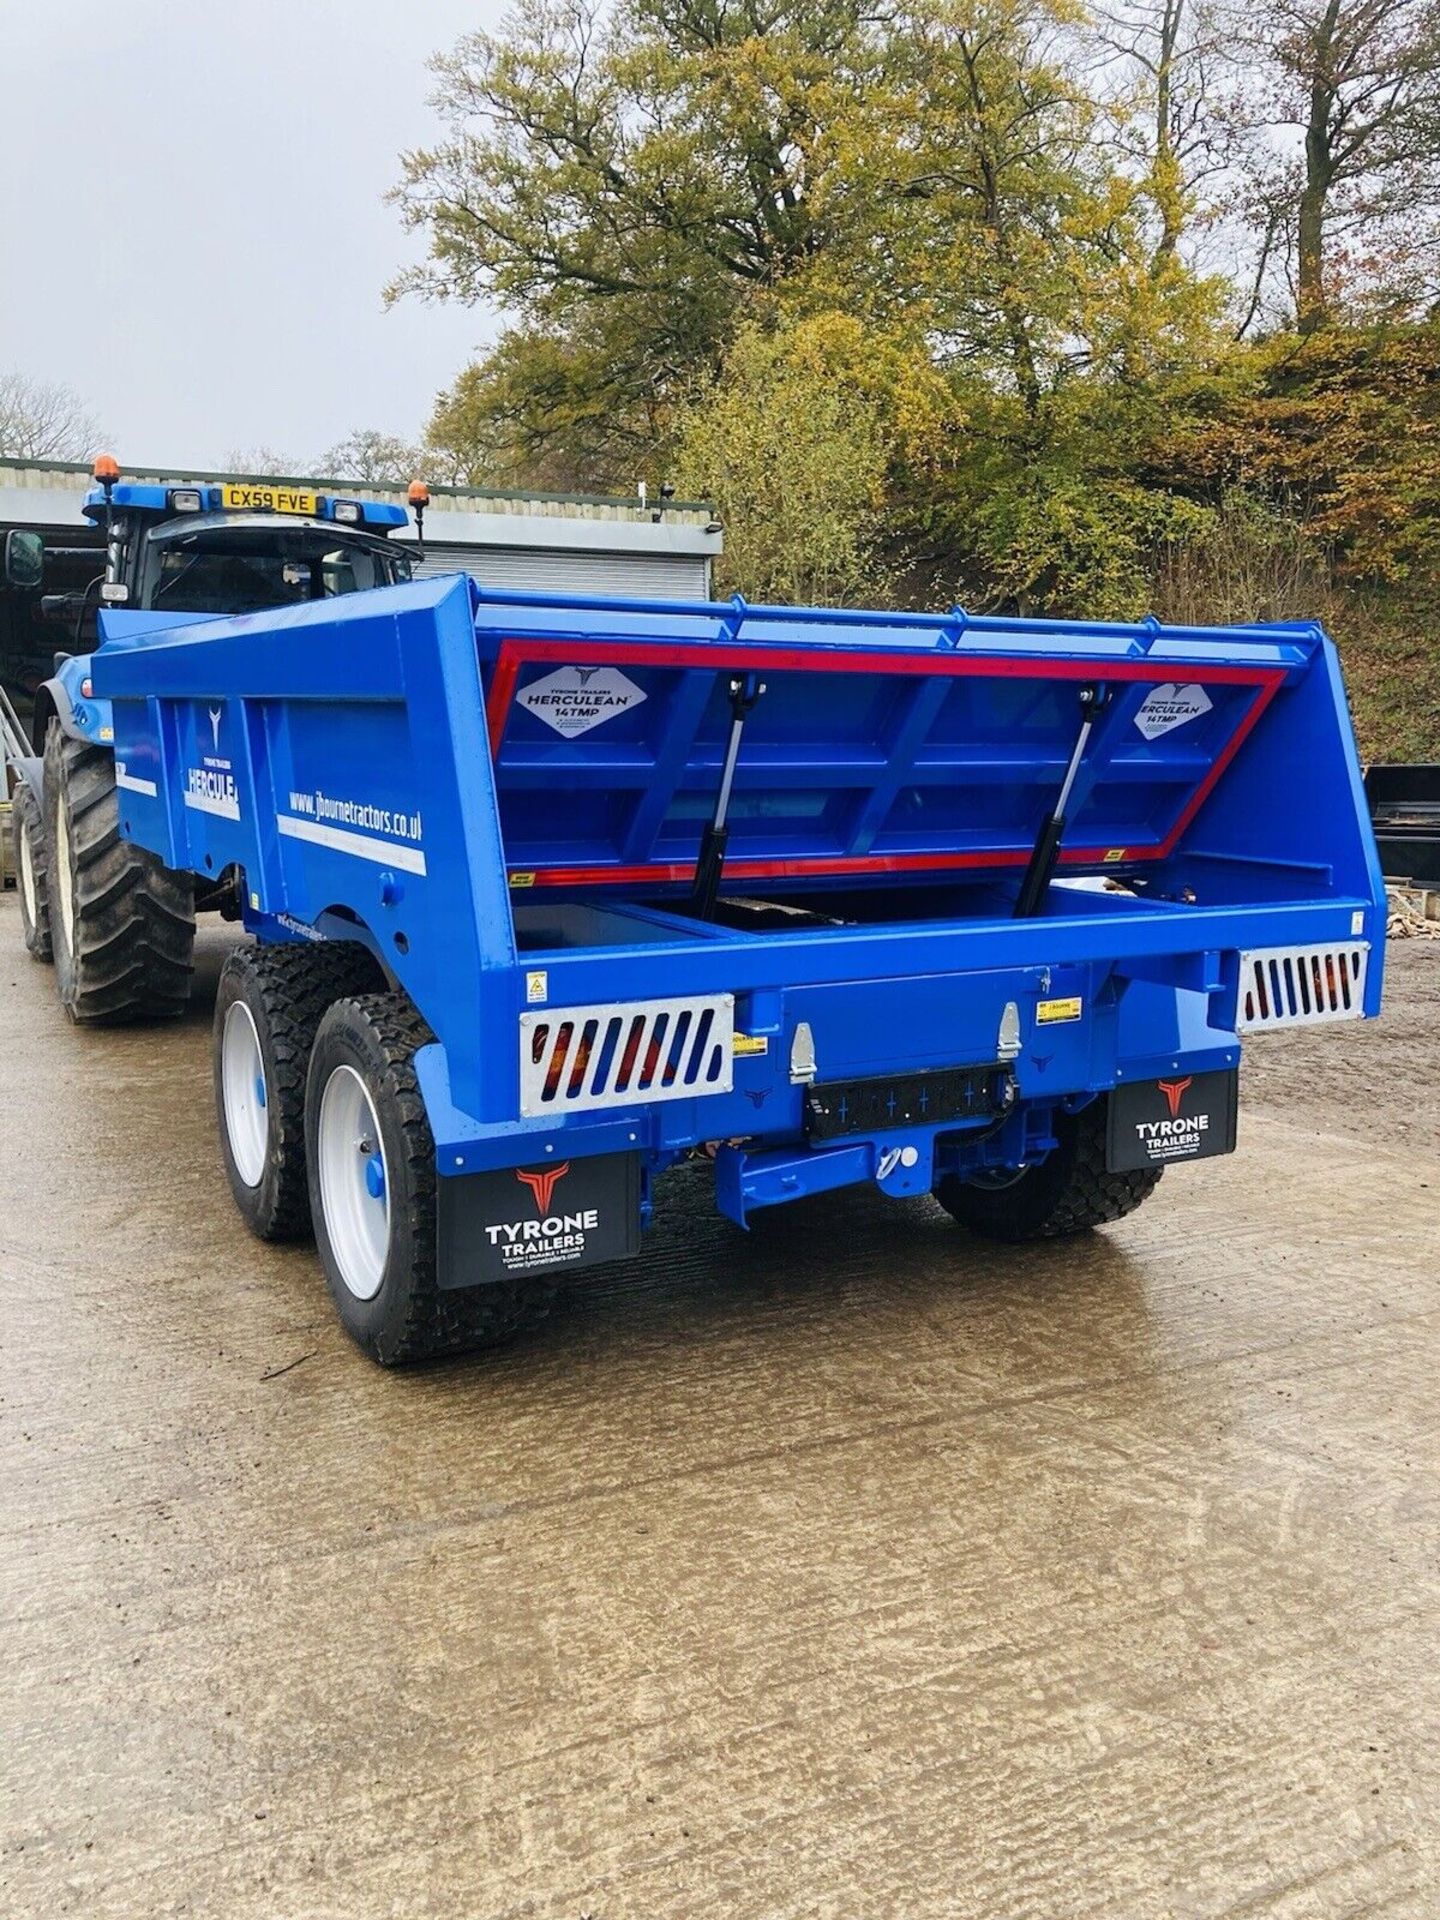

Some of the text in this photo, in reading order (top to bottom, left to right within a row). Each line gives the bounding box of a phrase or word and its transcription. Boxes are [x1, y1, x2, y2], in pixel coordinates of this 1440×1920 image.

[230, 490, 309, 511] CX59 FVE
[527, 695, 629, 706] HERCULEAN
[1141, 705, 1200, 714] ERCULEAN
[555, 708, 600, 717] 14TMP
[188, 768, 240, 804] HERCULE
[1136, 1115, 1208, 1139] TYRONE
[1146, 1132, 1200, 1148] TRAILERS
[485, 1210, 598, 1244] TYRONE
[502, 1233, 585, 1257] TRAILERS
